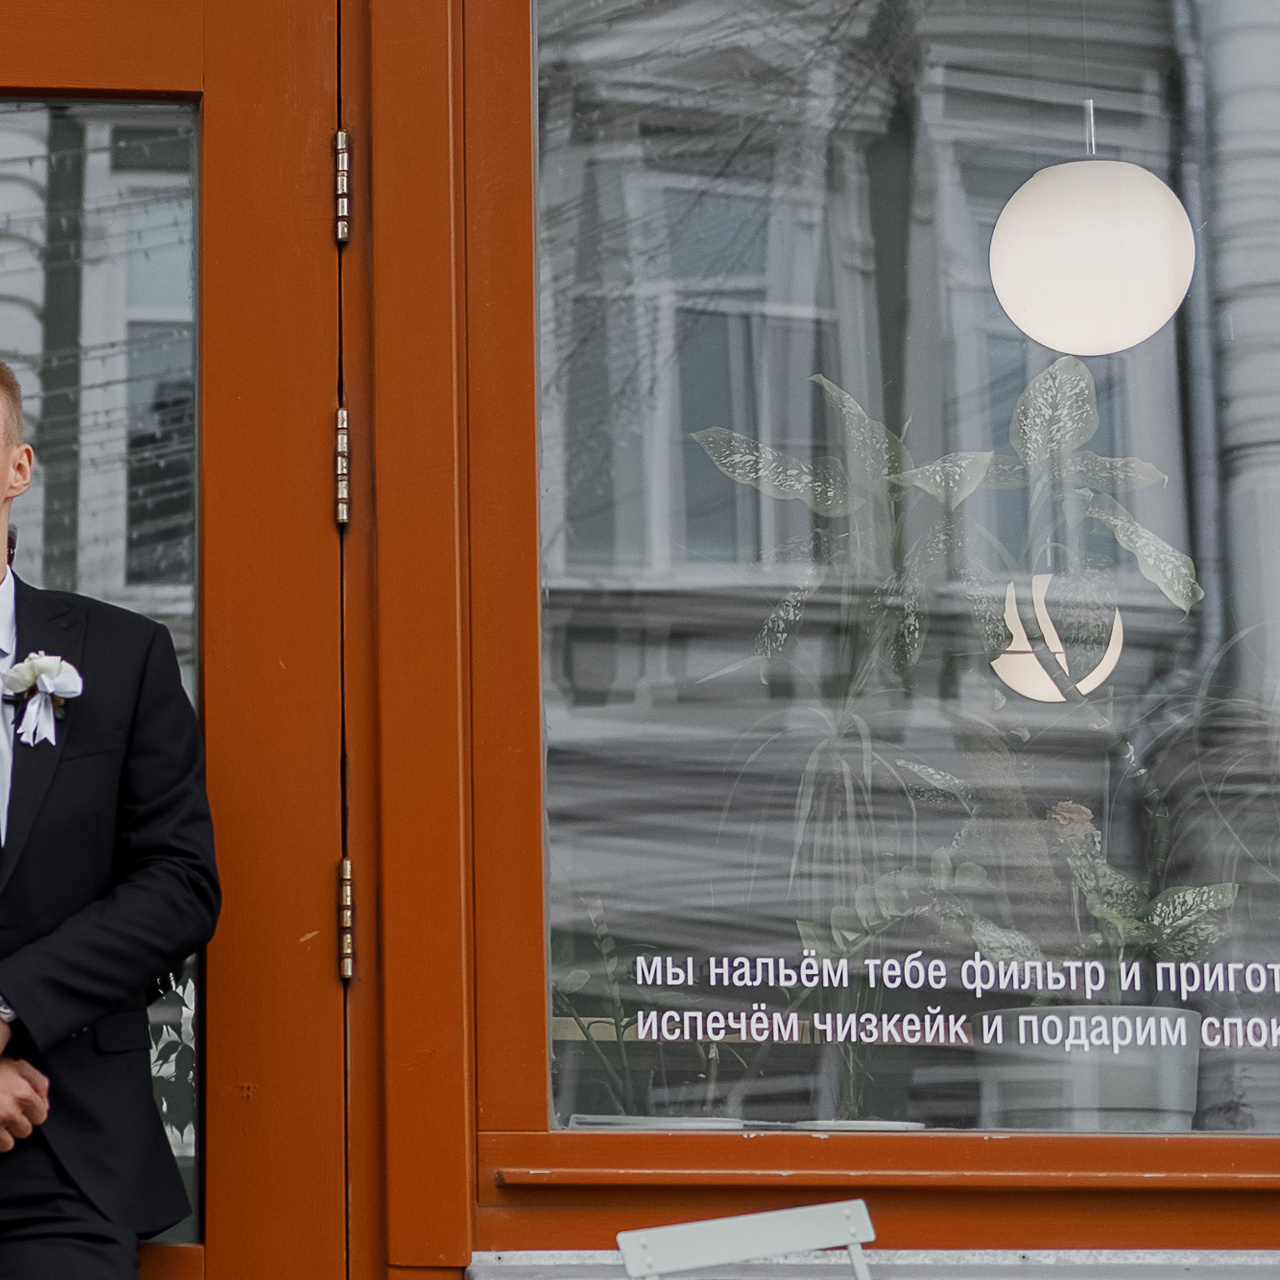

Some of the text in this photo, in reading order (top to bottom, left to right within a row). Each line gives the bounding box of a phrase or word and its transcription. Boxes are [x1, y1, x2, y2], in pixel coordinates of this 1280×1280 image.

[636, 949, 1280, 1000] мы нальём тебе фильтр и пригот
[637, 1004, 800, 1043] испечём
[814, 1006, 969, 1045] чизкейк
[983, 1012, 1004, 1044] и
[1019, 1012, 1187, 1054] подарим
